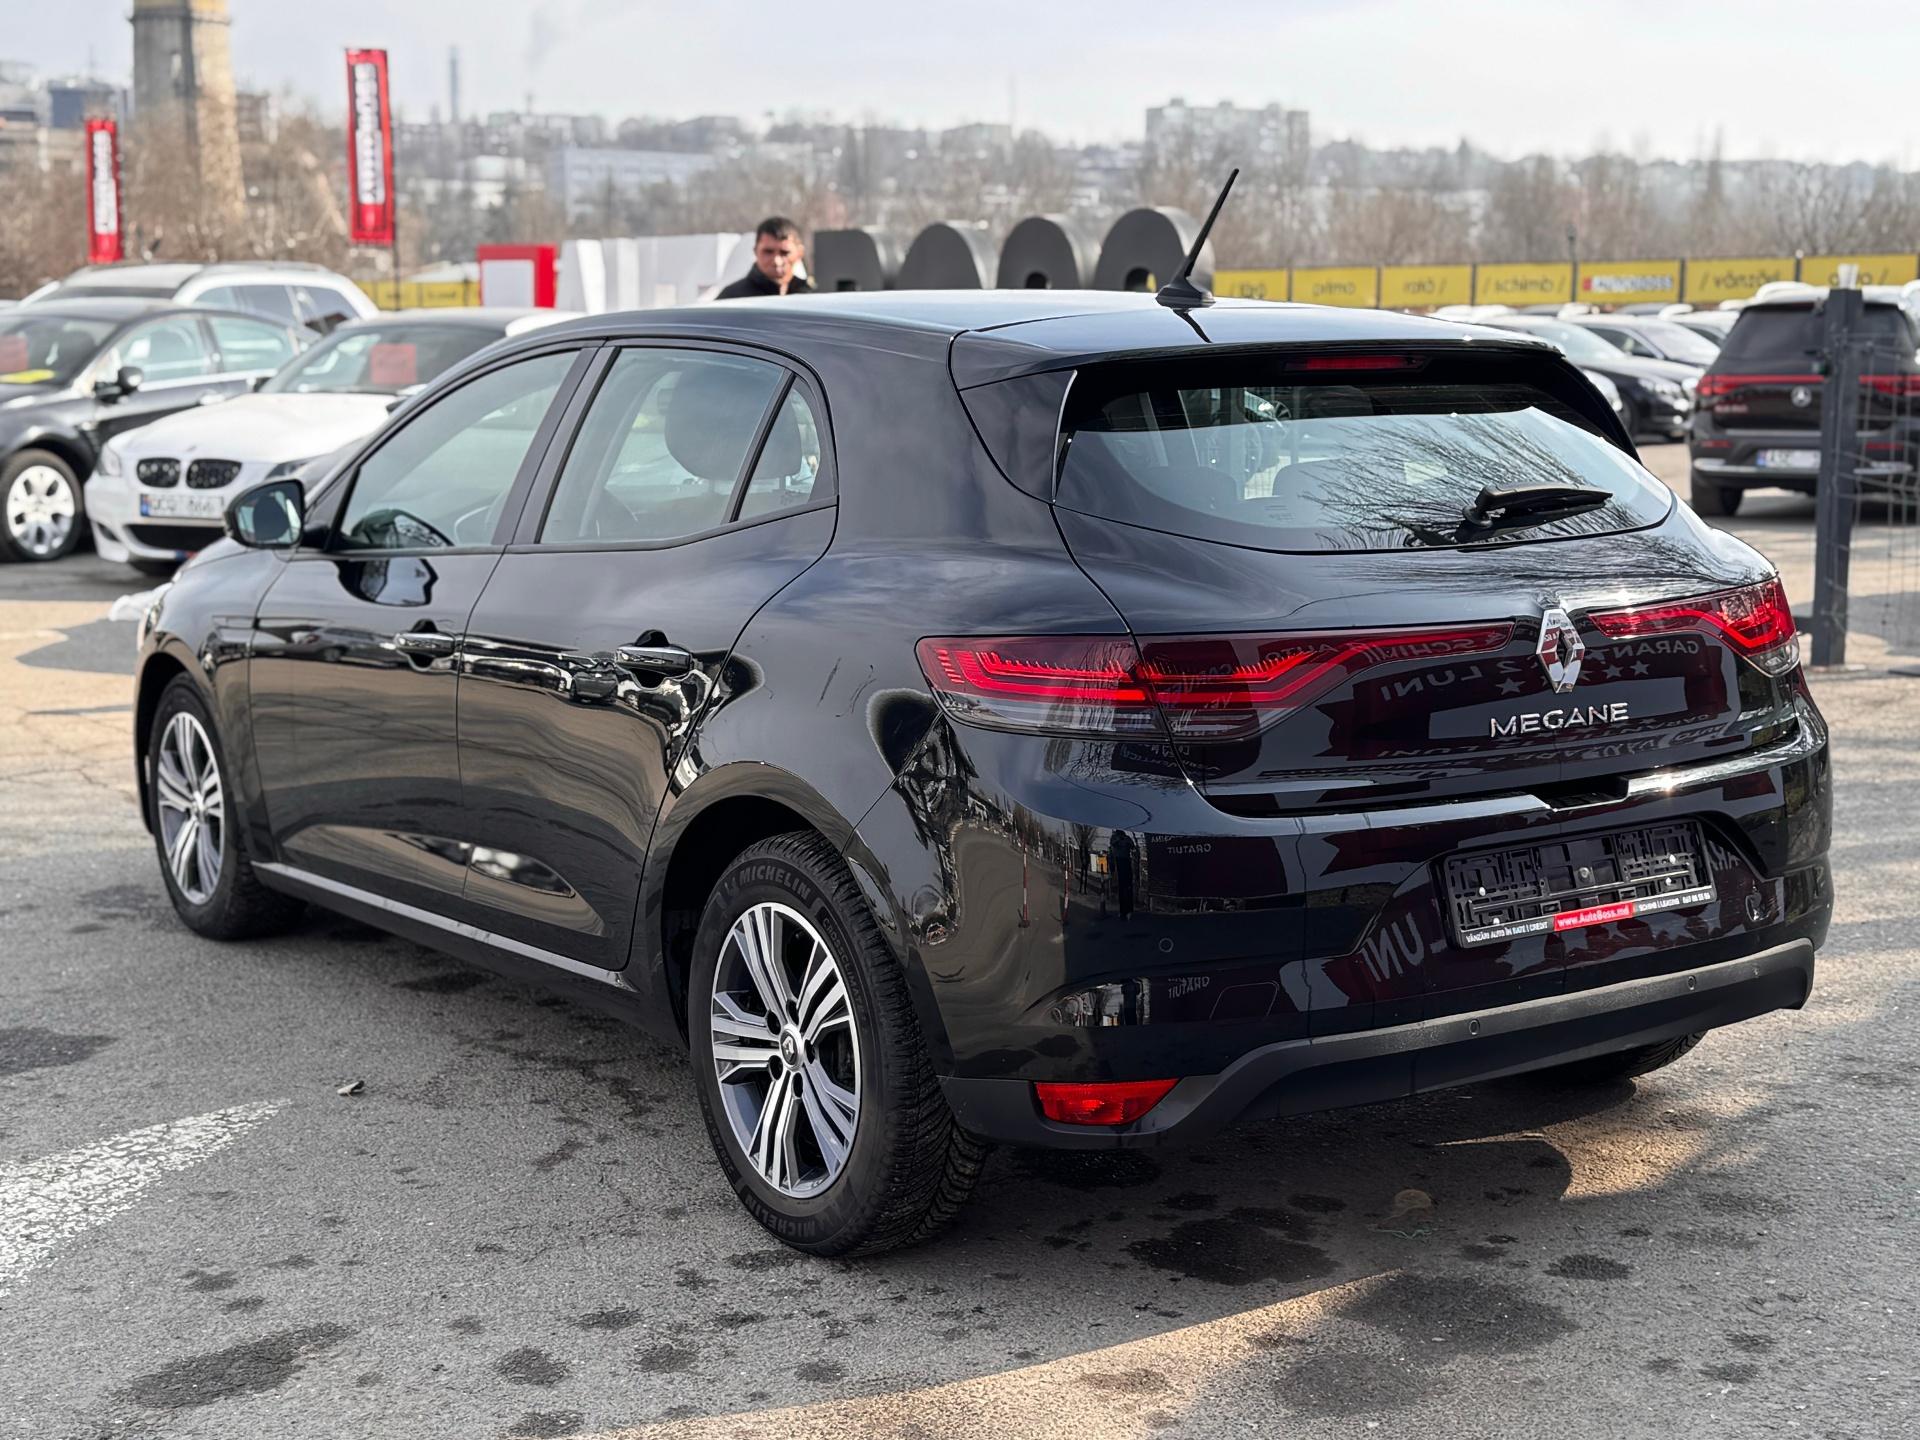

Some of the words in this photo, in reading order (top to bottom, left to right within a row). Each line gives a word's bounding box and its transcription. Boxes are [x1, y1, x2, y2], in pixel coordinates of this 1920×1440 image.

[1490, 701, 1630, 738] MEGANE
[738, 863, 812, 900] MICHELIN
[1557, 904, 1631, 927] www.AutoBoss.md
[744, 1193, 817, 1238] MICHELIN
